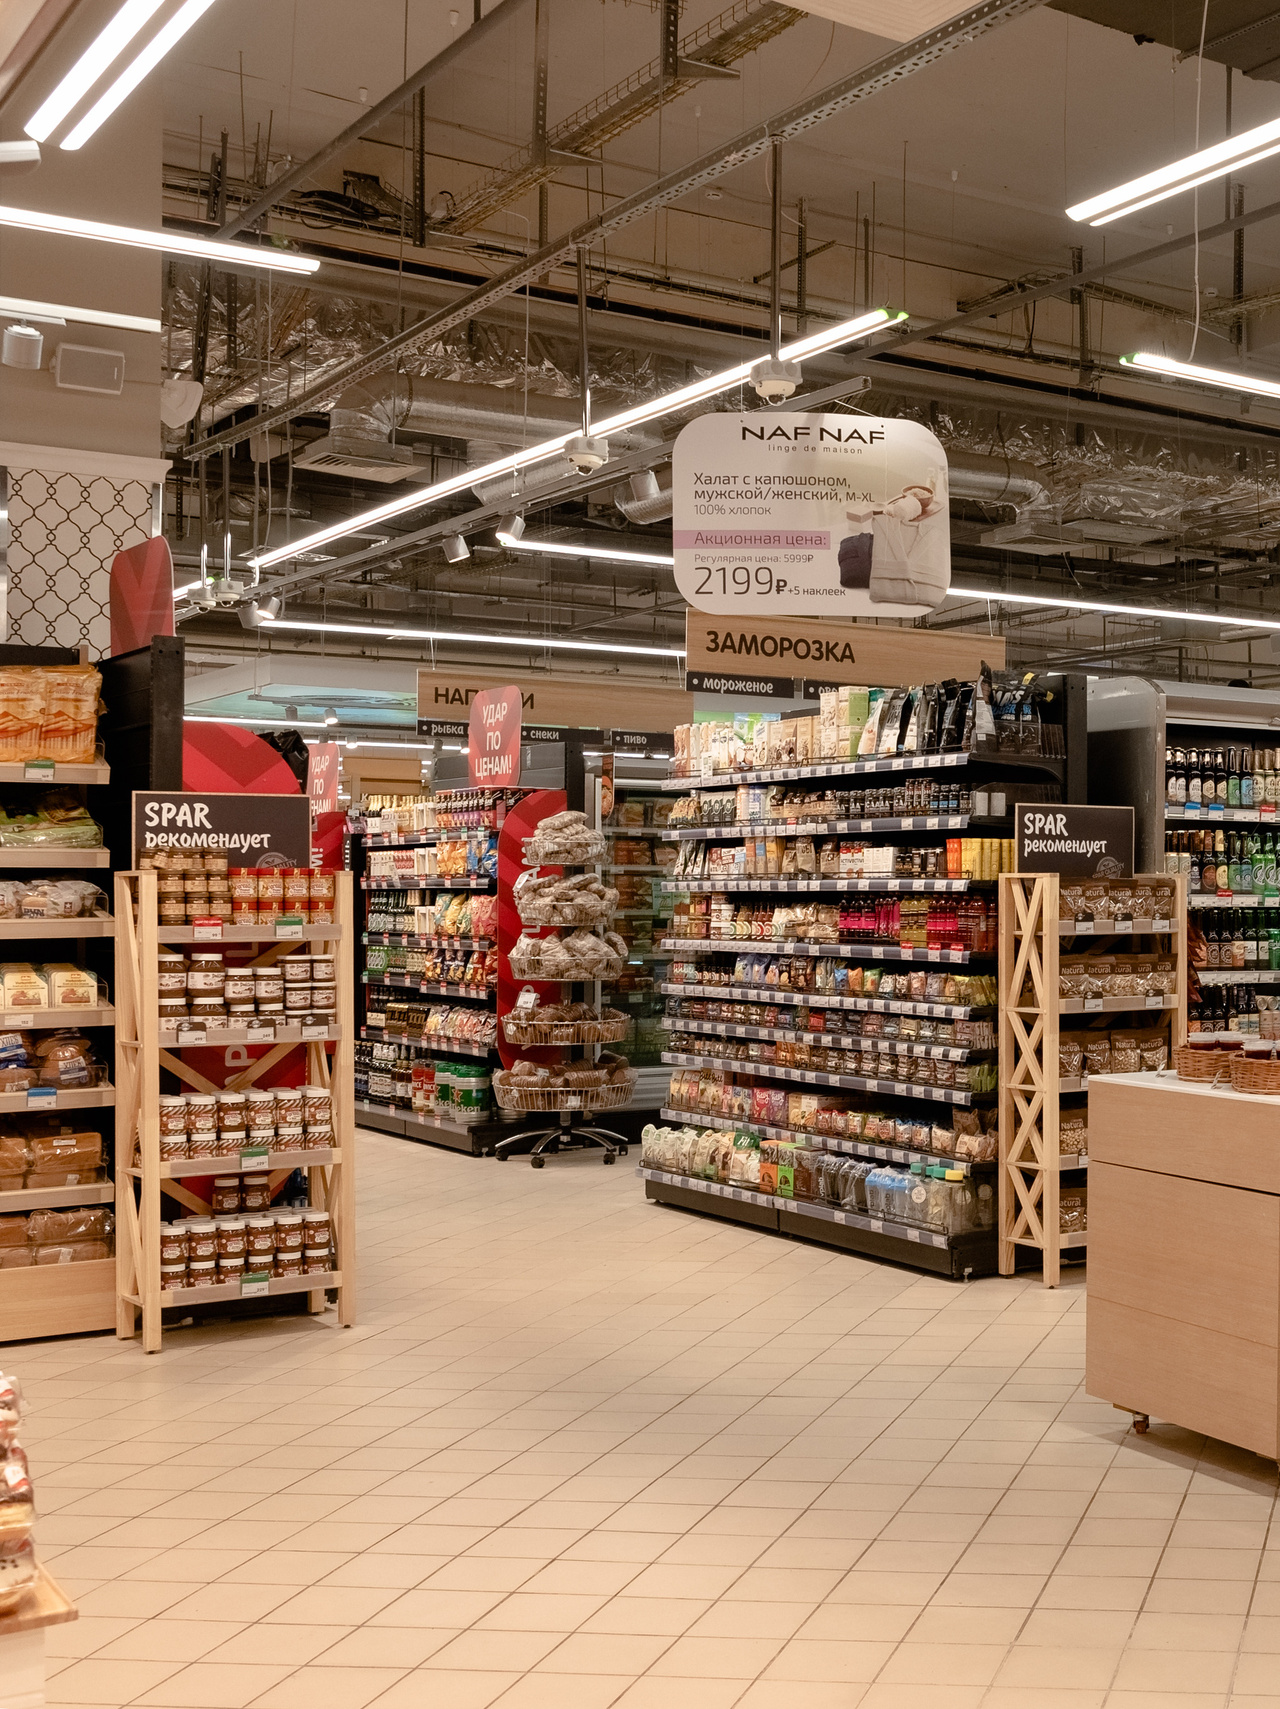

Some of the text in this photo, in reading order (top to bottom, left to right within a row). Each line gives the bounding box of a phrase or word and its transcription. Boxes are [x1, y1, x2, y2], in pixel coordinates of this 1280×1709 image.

[741, 423, 885, 445] NAF NAF
[768, 444, 863, 455] linge de maison
[694, 472, 739, 486] Халат
[755, 475, 851, 488] капюшоном,
[694, 487, 875, 503] мужской/женский, M-XL
[694, 504, 771, 516] 100% хлопок
[694, 532, 827, 547] Акционная цена:
[694, 554, 752, 566] Регулярная
[755, 555, 782, 565] цена:
[788, 586, 800, 596] +5
[802, 587, 846, 597] наклеек
[705, 630, 856, 664] ЗАМОРОЗКА
[703, 677, 774, 694] мороженое
[434, 687, 535, 709] НАПИ
[482, 702, 508, 726] УДАР
[431, 724, 464, 736] рыбка
[530, 729, 559, 740] снеки
[486, 731, 501, 750] ПО
[623, 735, 647, 745] пиво
[311, 755, 330, 775] УДАР
[475, 753, 512, 780] ЦЕНАМ!
[313, 779, 324, 795] ПО
[144, 802, 212, 829] SPAR
[1024, 813, 1068, 836] SPAR
[145, 832, 271, 853] рекомендует
[1024, 838, 1107, 857] рекомендует
[1085, 886, 1105, 897] atural
[1061, 965, 1084, 974] Natural
[1060, 1199, 1081, 1207] atural
